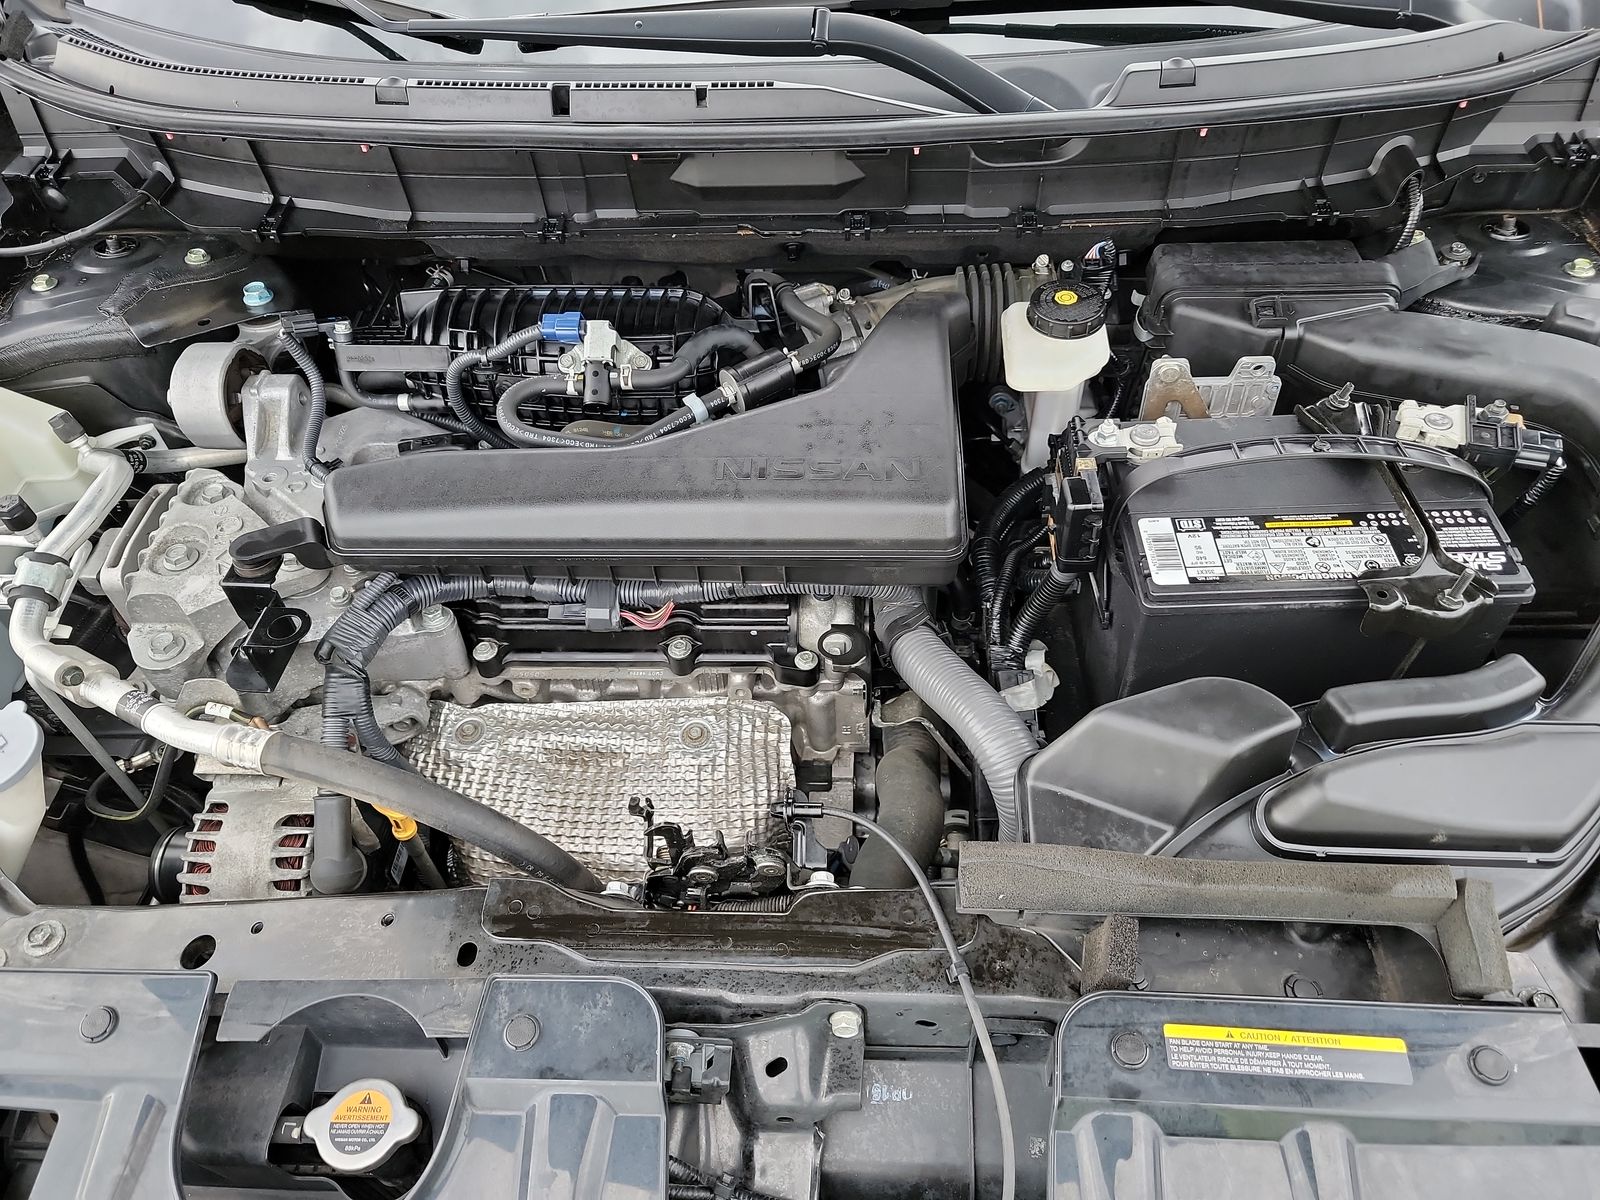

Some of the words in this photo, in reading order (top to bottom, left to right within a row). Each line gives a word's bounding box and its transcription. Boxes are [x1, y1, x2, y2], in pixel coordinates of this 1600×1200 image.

[716, 457, 921, 481] NISSAN
[1169, 1038, 1180, 1046] FAN
[1182, 1039, 1200, 1047] BLADE
[1239, 1031, 1281, 1042] CAUTION
[1291, 1036, 1342, 1046] ATTENTION
[1179, 1054, 1216, 1062] VENTILATEUR
[1295, 1069, 1331, 1077] APPROCHER
